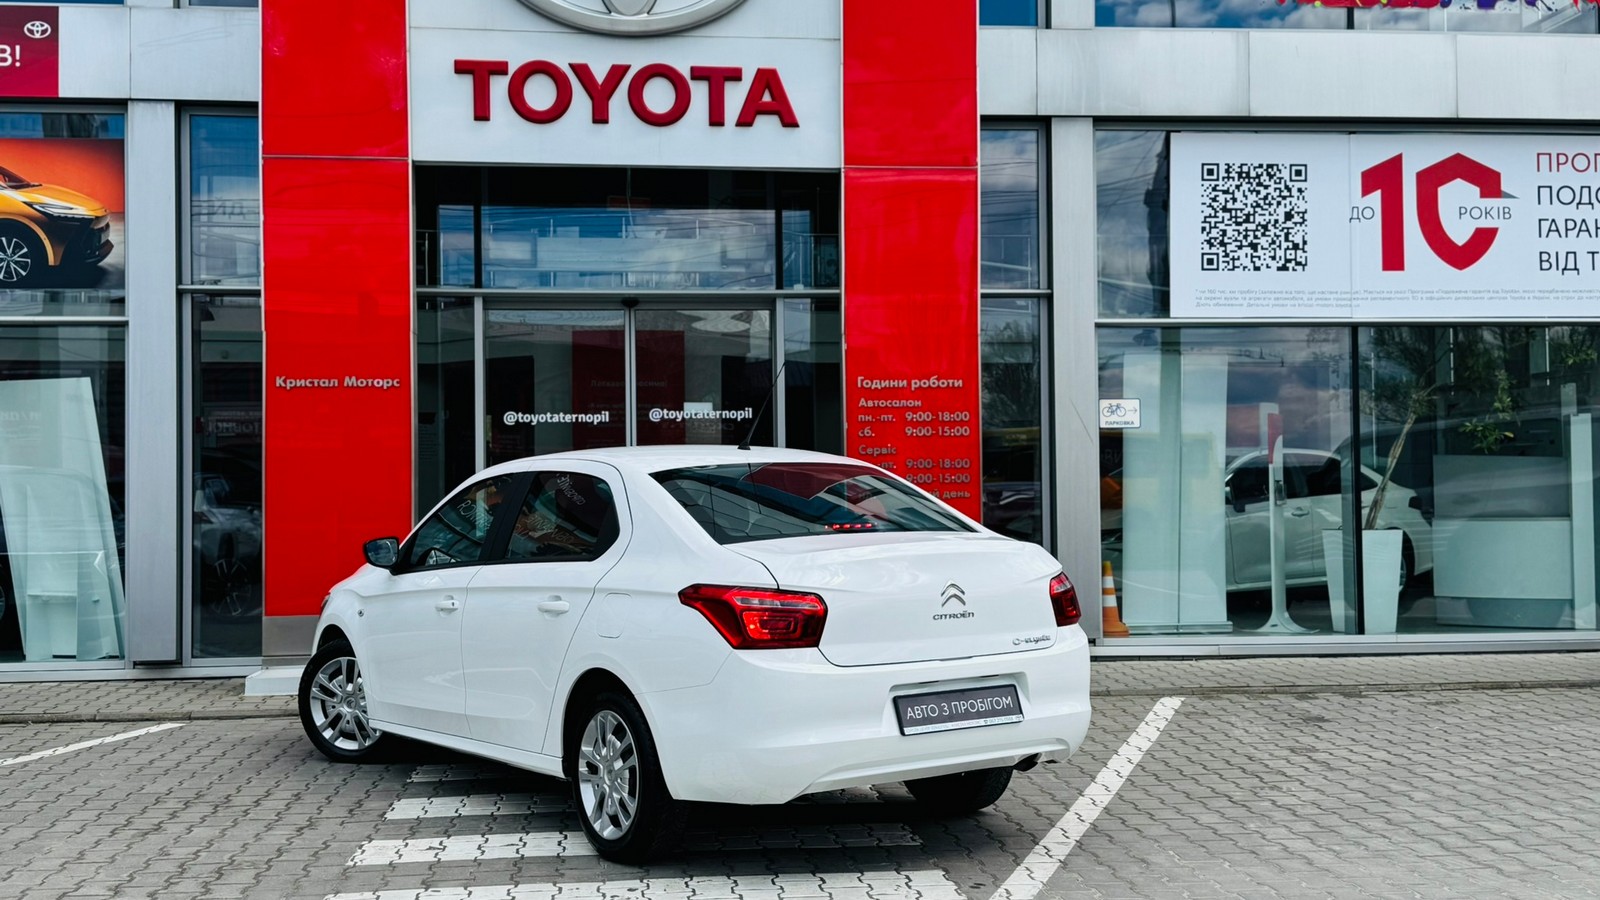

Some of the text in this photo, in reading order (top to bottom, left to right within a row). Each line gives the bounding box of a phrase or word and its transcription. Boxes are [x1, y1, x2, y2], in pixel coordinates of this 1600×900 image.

[454, 59, 800, 128] TOYOTA
[1538, 185, 1600, 210] ПОД
[1349, 206, 1375, 223] ДО
[1458, 206, 1512, 220] РОКІВ
[1539, 251, 1580, 276] ВІД
[276, 376, 400, 390] Кристал Моторс
[858, 375, 963, 391] Години роботи
[858, 398, 922, 407] Автосалон
[503, 411, 610, 426] @toyotaternopil
[648, 408, 752, 422] @toyotaternopil
[905, 412, 970, 421] 9:00-18:00
[858, 426, 970, 436] сб. 9:00-15:00
[859, 444, 896, 456] Сервіс
[906, 459, 970, 468] 9:00-18:00
[943, 491, 970, 499] день
[907, 704, 938, 720] АВТО
[951, 696, 1013, 714] ПРОБІГОМ
